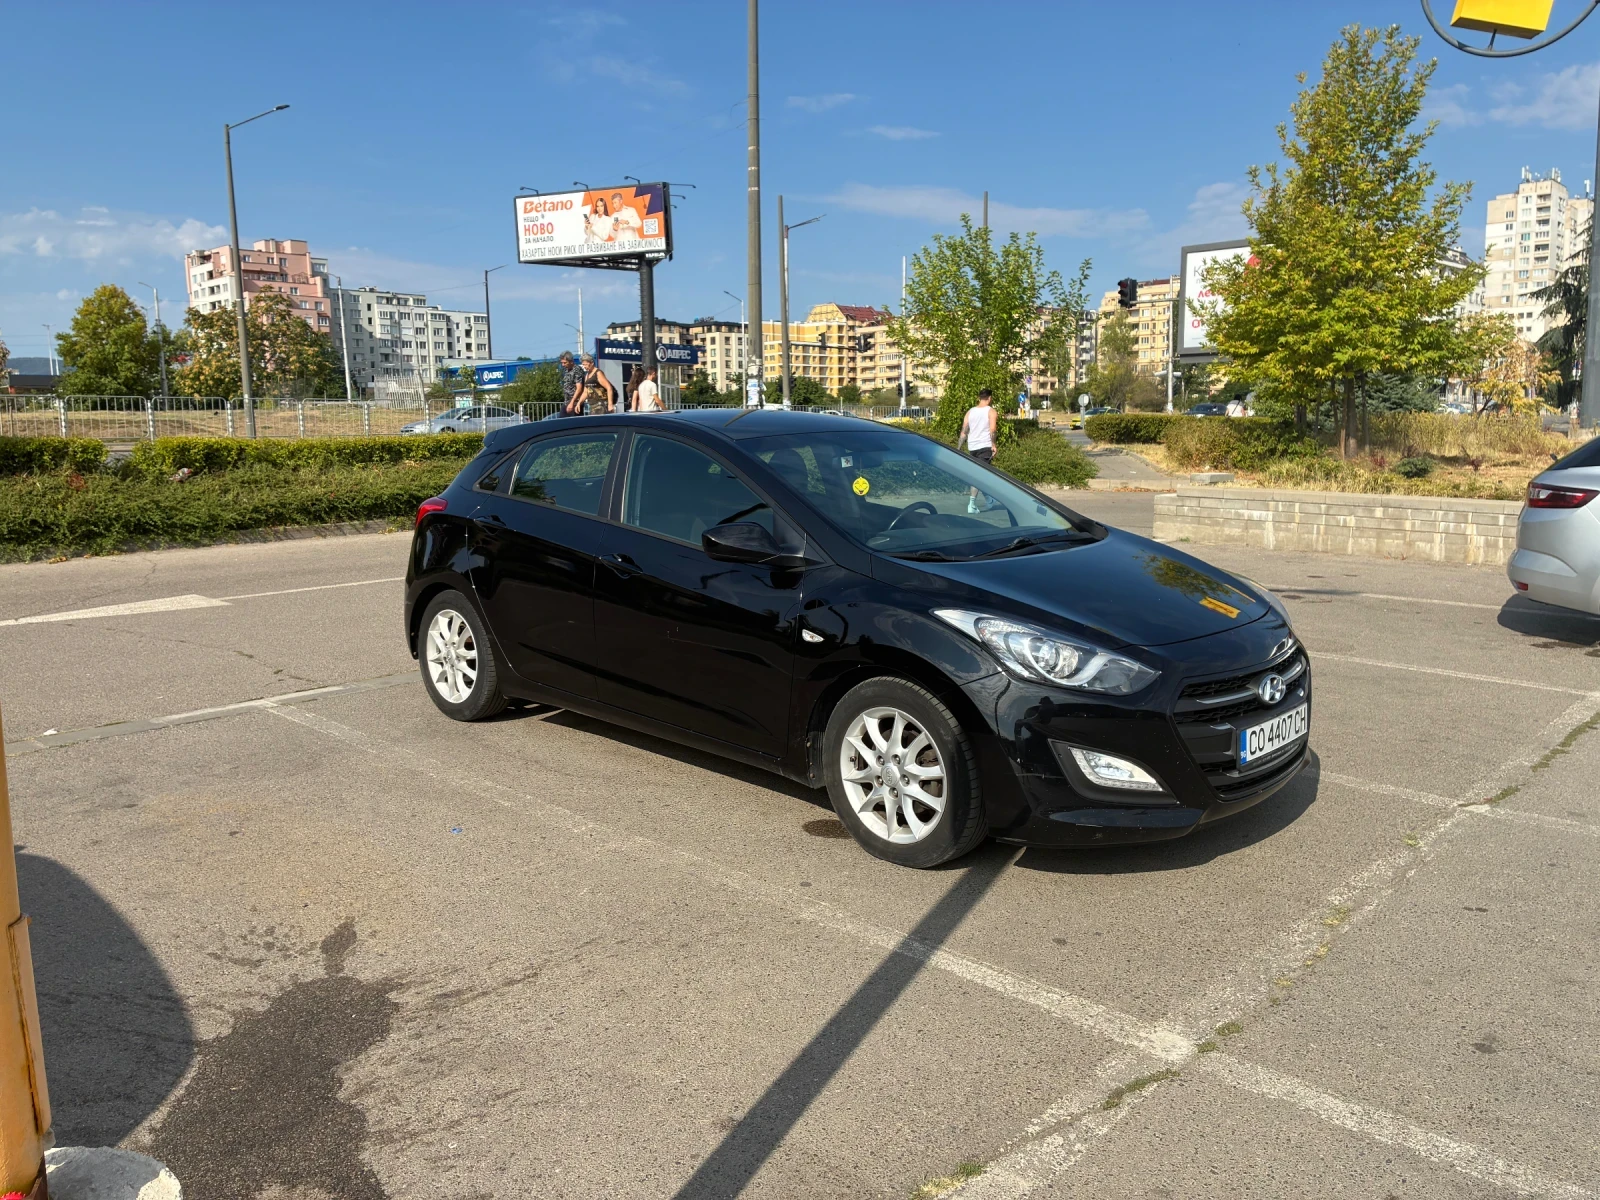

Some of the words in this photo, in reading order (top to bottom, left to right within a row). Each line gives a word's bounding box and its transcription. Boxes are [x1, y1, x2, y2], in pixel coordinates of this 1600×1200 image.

[523, 200, 573, 214] Betano
[523, 215, 539, 223] НЕЩО
[524, 222, 554, 236] НОВО
[522, 247, 546, 258] ХАЗАРТЪТ
[548, 246, 562, 256] НОСИ
[564, 245, 577, 254] РИСК
[578, 244, 585, 253] ОТ
[587, 241, 616, 253] РАЗВИВАНЕ
[618, 242, 626, 250] НА
[627, 238, 663, 249] ЗАВИСИМОСТ
[667, 349, 692, 360] АДРЕС
[1249, 728, 1265, 755] CO
[1267, 714, 1293, 747] 4407
[1294, 706, 1306, 734] CH
